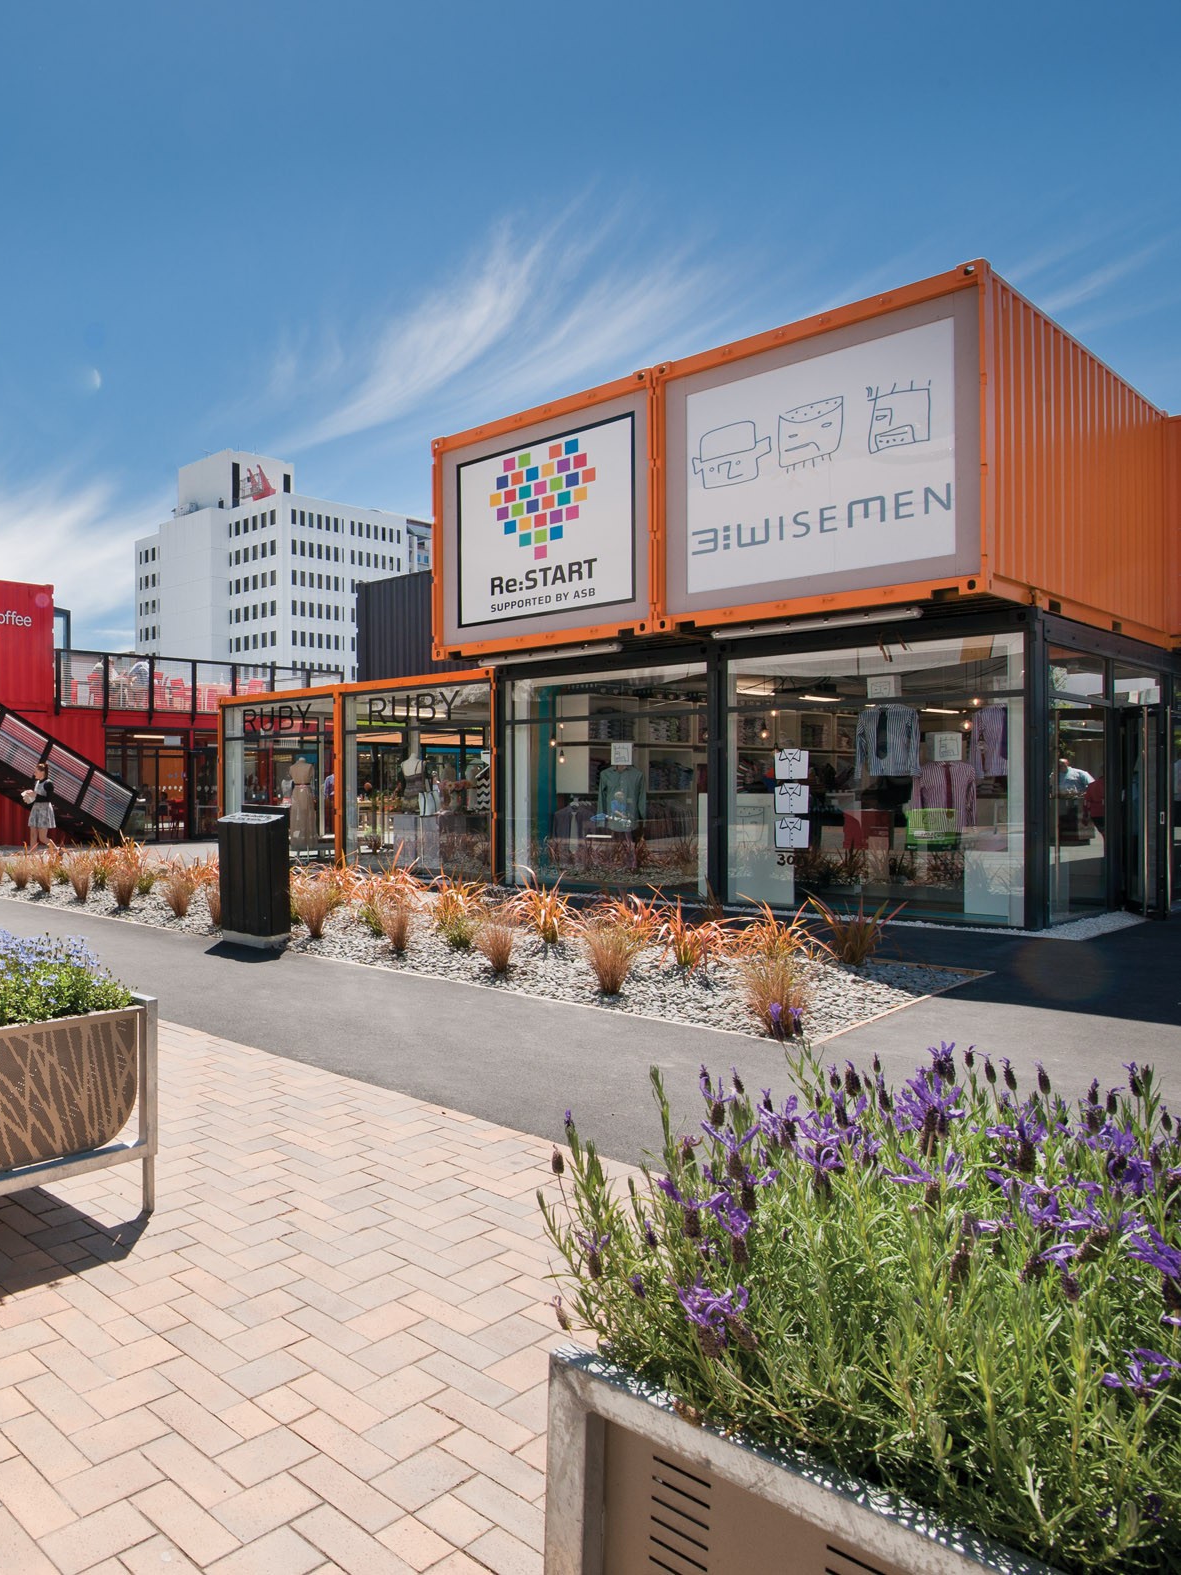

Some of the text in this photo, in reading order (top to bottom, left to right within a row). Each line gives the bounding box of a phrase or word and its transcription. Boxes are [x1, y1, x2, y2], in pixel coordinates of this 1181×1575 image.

[491, 558, 597, 596] Re:START
[491, 587, 596, 613] SUPPORTED BY ASB
[242, 703, 312, 733] RUBY
[369, 690, 461, 725] RUBY
